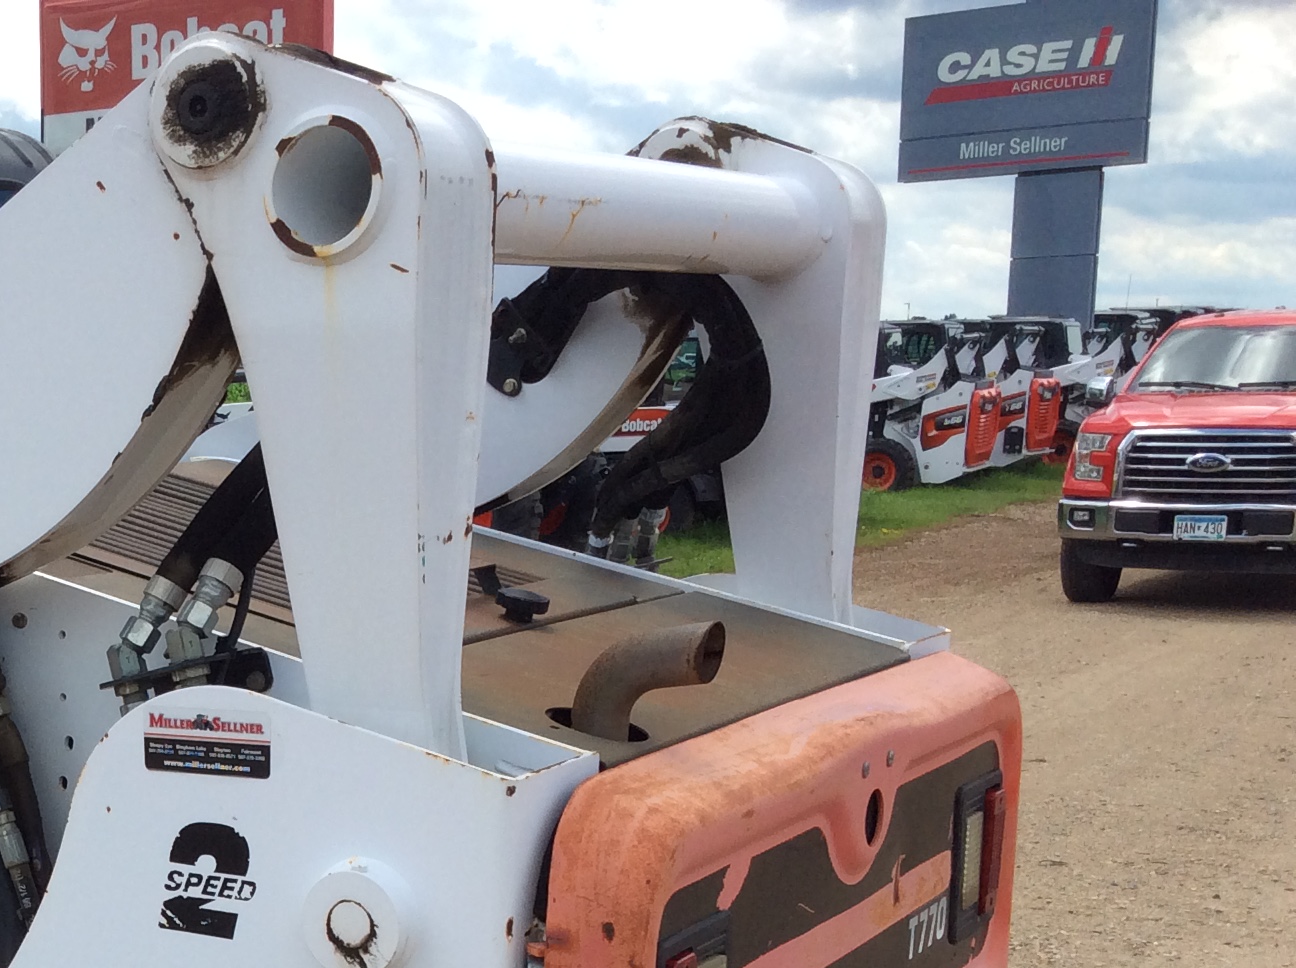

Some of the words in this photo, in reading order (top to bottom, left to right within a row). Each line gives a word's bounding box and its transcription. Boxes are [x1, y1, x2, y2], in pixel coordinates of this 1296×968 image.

[937, 40, 1073, 83] CASE
[1011, 74, 1106, 93] AGRICULTURE
[959, 141, 1004, 159] Miller
[1010, 136, 1067, 154] Sellner
[1177, 522, 1195, 534] HAN
[1203, 522, 1223, 534] 430
[158, 822, 250, 940] 2
[164, 870, 256, 901] SPEED
[909, 897, 947, 960] T770
